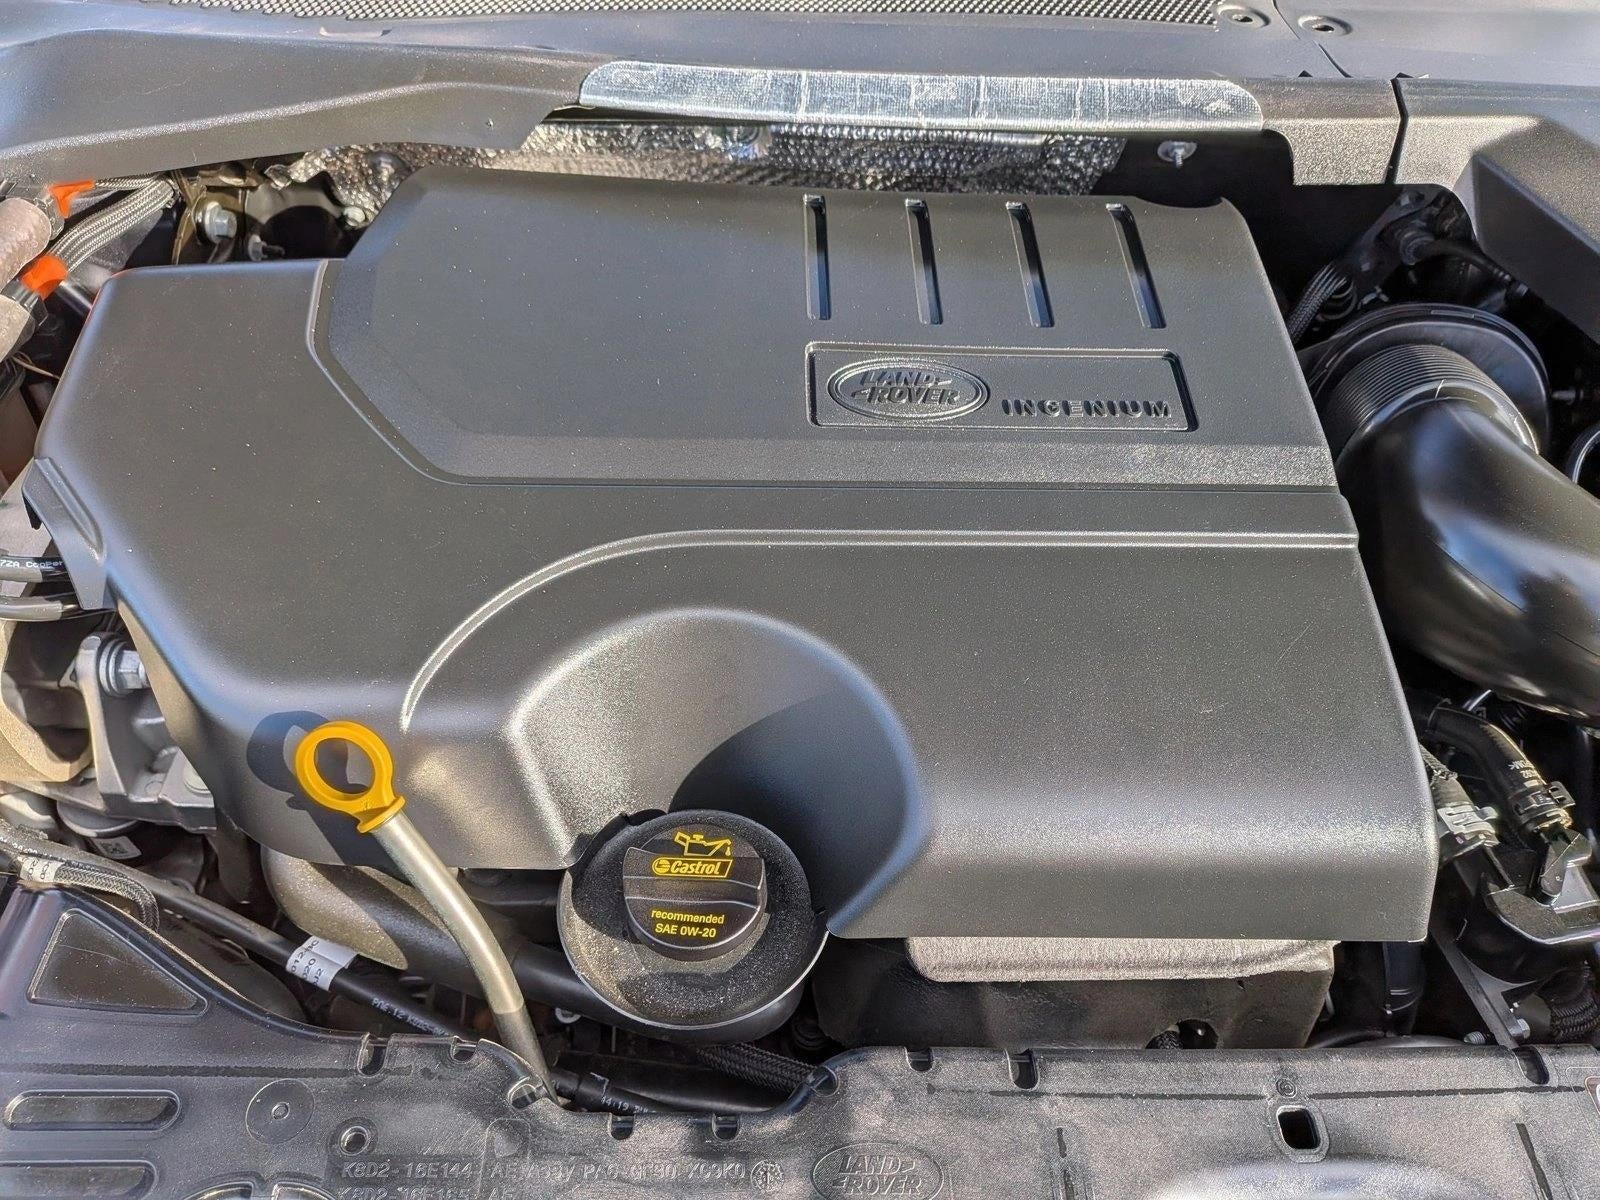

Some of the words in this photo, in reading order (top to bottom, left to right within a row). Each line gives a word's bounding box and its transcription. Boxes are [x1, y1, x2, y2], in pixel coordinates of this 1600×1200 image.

[861, 370, 931, 387] LAND
[863, 387, 960, 405] ROVER
[1002, 400, 1172, 417] INGENIUM
[670, 860, 720, 875] Castrol
[651, 909, 725, 924] recommended
[655, 923, 678, 933] SAE
[680, 926, 717, 938] 0W-20
[840, 1155, 902, 1175] LAND
[842, 1176, 922, 1195] ROVER
